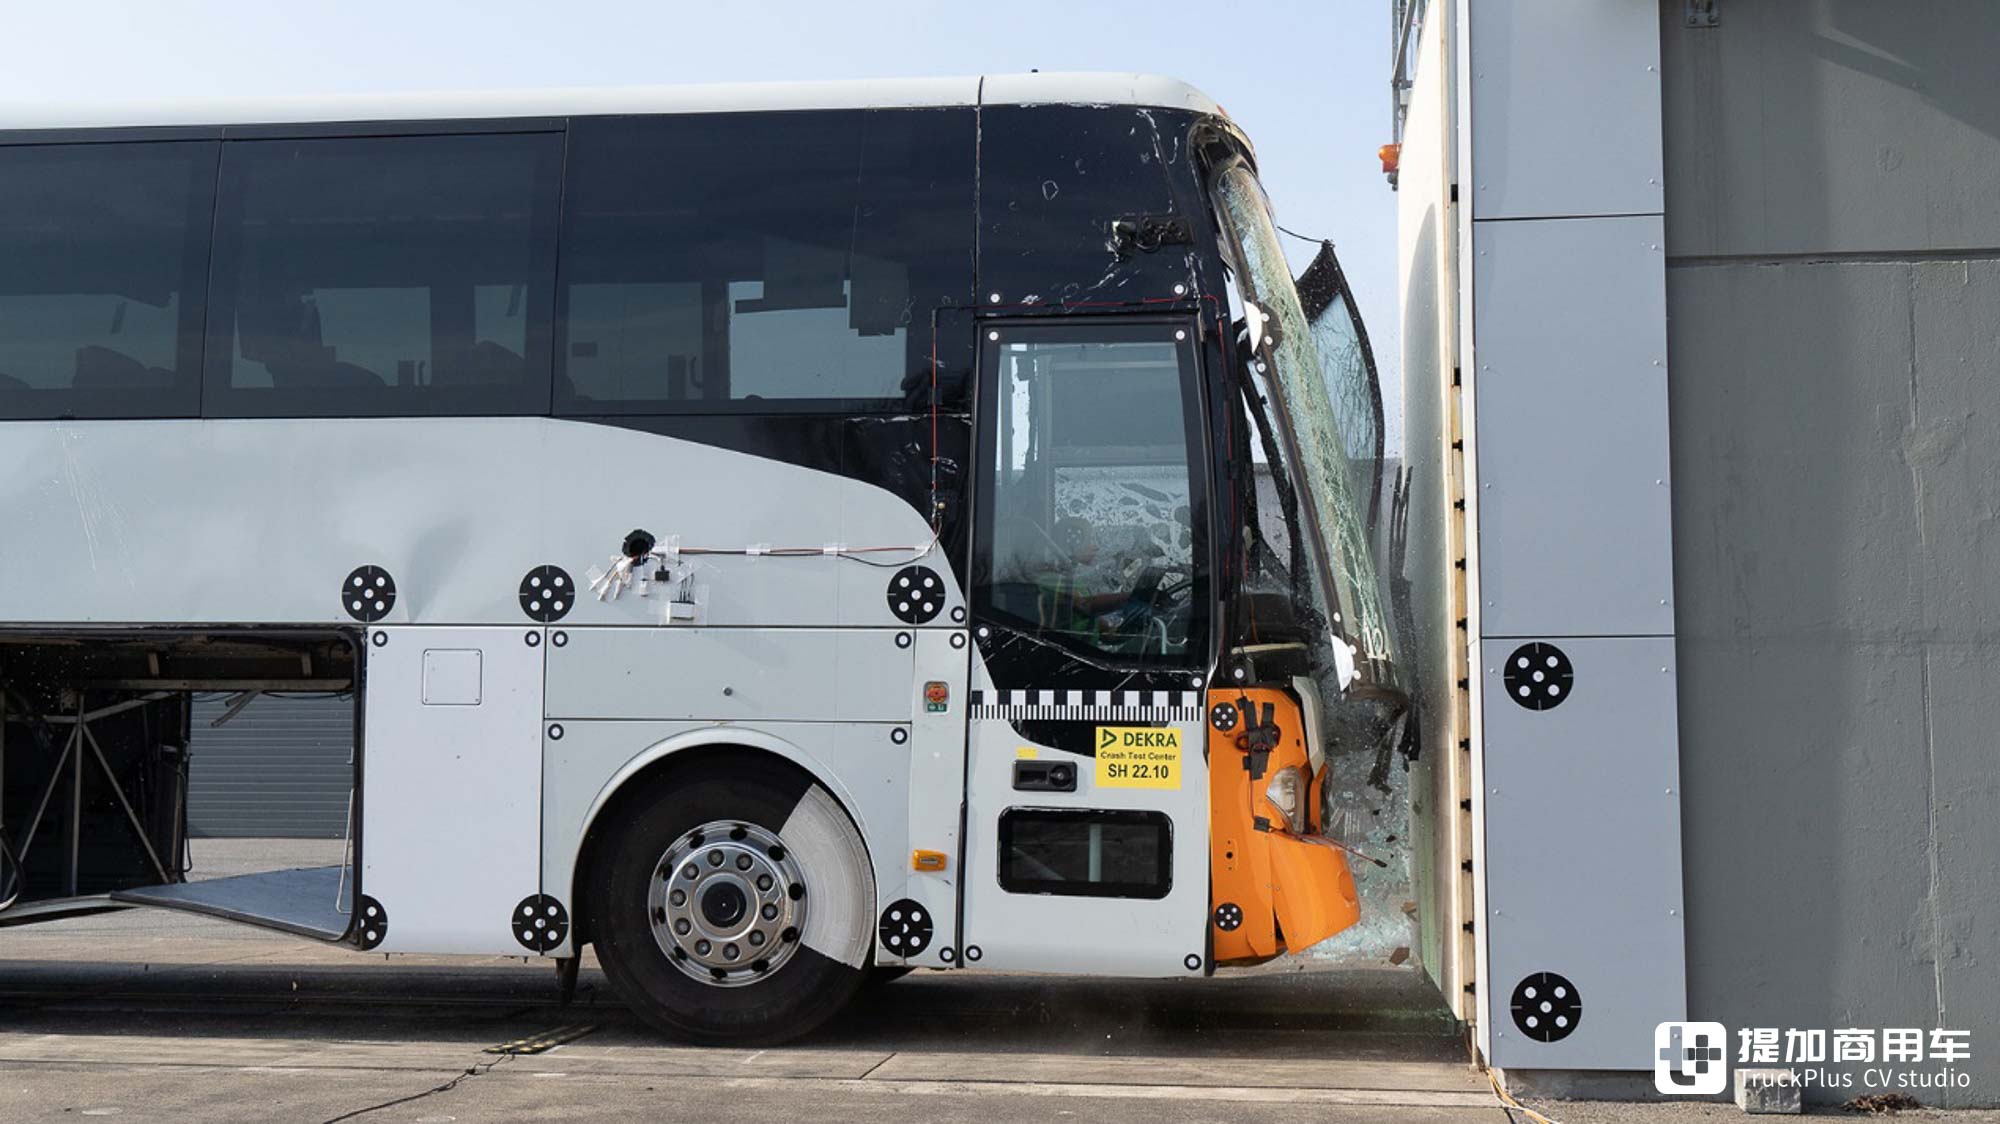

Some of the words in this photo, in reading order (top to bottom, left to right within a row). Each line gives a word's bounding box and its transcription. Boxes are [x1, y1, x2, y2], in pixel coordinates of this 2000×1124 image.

[1124, 732, 1177, 747] DEKRA
[1100, 751, 1126, 760] Crash
[1128, 751, 1146, 760] Test
[1148, 752, 1176, 760] Center
[1108, 763, 1128, 778] SH
[1132, 764, 1169, 779] 22.10
